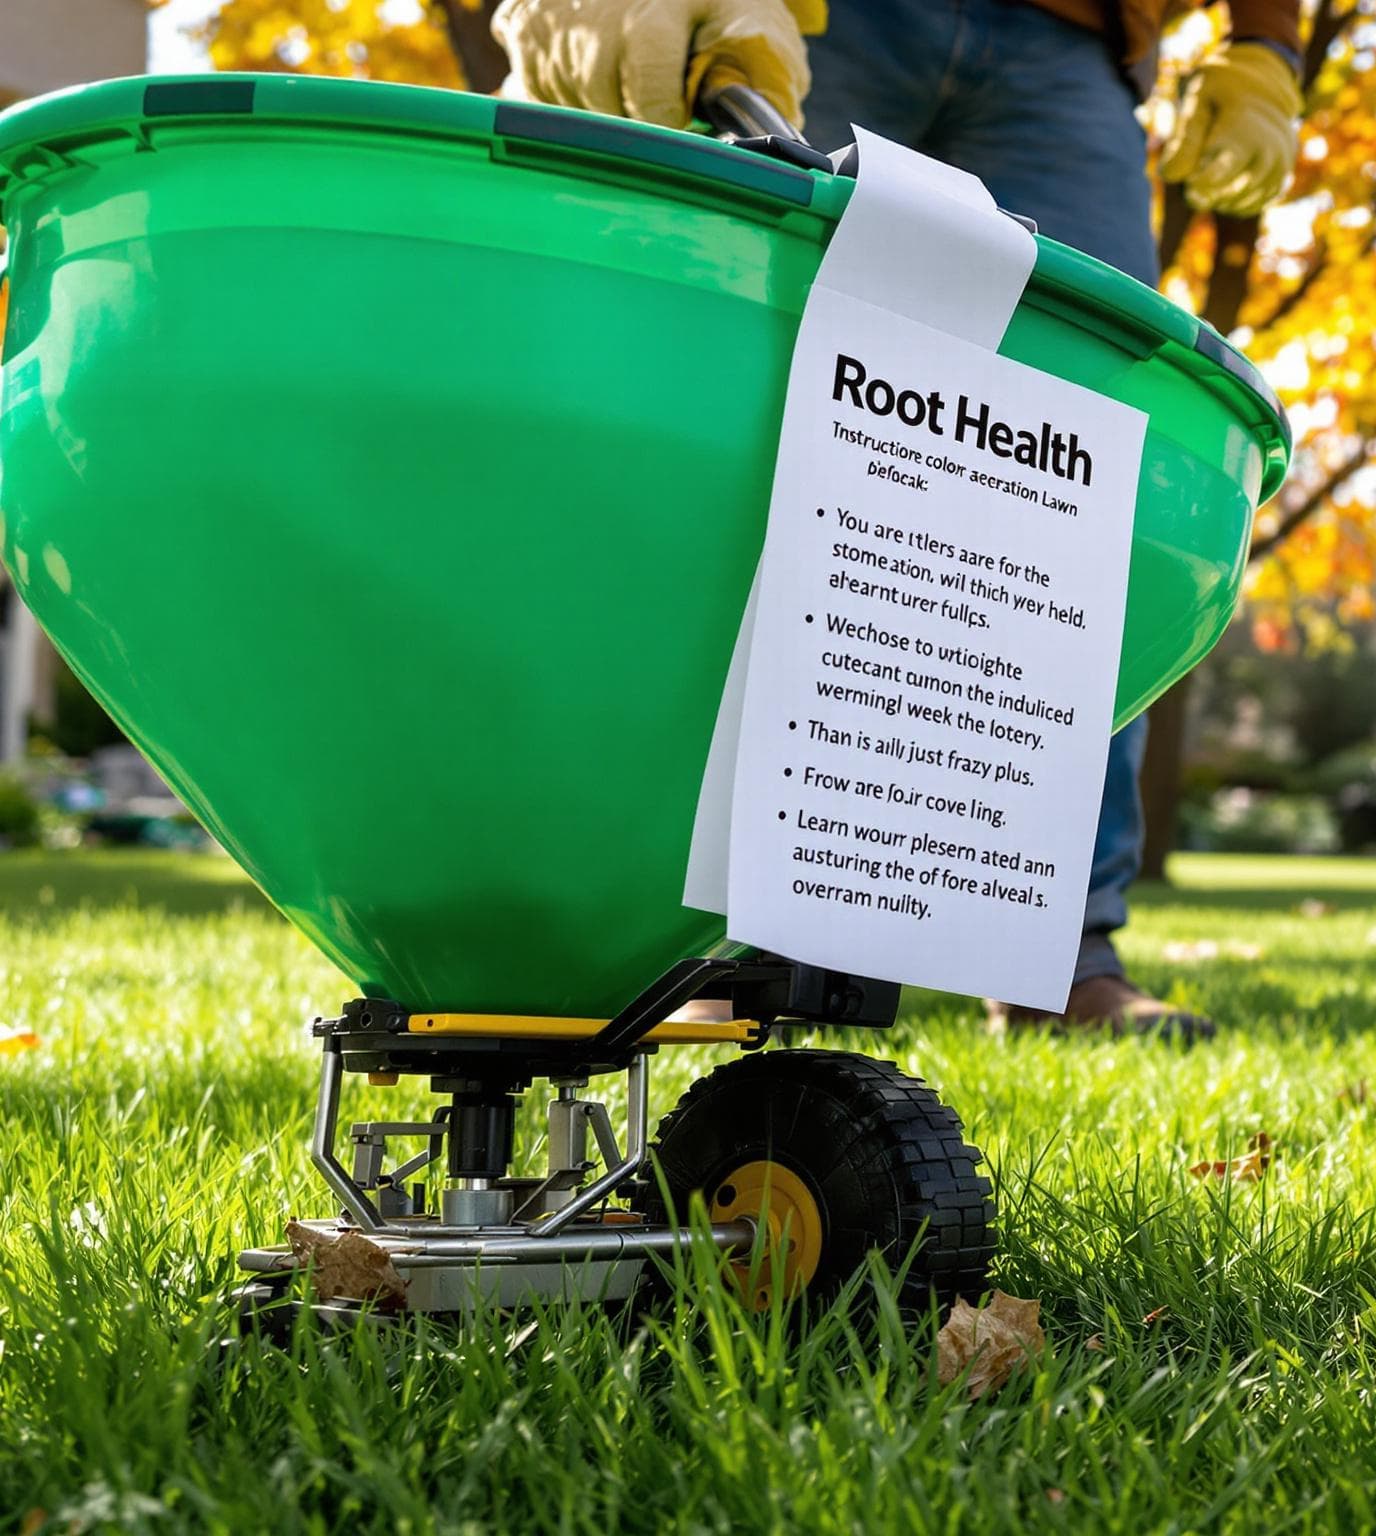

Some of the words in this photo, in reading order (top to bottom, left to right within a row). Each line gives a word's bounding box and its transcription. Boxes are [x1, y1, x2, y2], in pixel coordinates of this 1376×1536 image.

[833, 354, 945, 437] Root
[955, 395, 1092, 489] Health
[1042, 491, 1077, 516] Lawn
[838, 508, 868, 533] You
[874, 525, 903, 543] are
[959, 549, 994, 569] aare
[999, 557, 1021, 577] for
[1025, 566, 1049, 587] the
[902, 593, 938, 613] urer
[941, 573, 965, 592] wil
[970, 579, 1008, 604] thich
[1049, 601, 1085, 629] held.
[827, 613, 909, 651] Wechose
[915, 638, 933, 656] to
[822, 652, 901, 682] cutecant
[968, 684, 994, 705] the
[999, 691, 1074, 725] induliced
[908, 703, 952, 726] week
[958, 712, 985, 734] the
[990, 719, 1043, 750] lotery.
[808, 720, 851, 746] Than
[857, 731, 870, 750] is
[907, 741, 943, 766] just
[948, 750, 991, 779] frazy
[995, 762, 1033, 786] plus.
[804, 767, 850, 792] Frow
[855, 782, 883, 799] are
[926, 796, 966, 816] cove
[798, 809, 848, 837] Learn
[981, 851, 1020, 870] ated
[1024, 860, 1054, 877] ann
[793, 847, 882, 879] austuring
[886, 860, 914, 882] the
[920, 868, 939, 885] of
[942, 869, 977, 893] fore
[793, 880, 871, 906] overram
